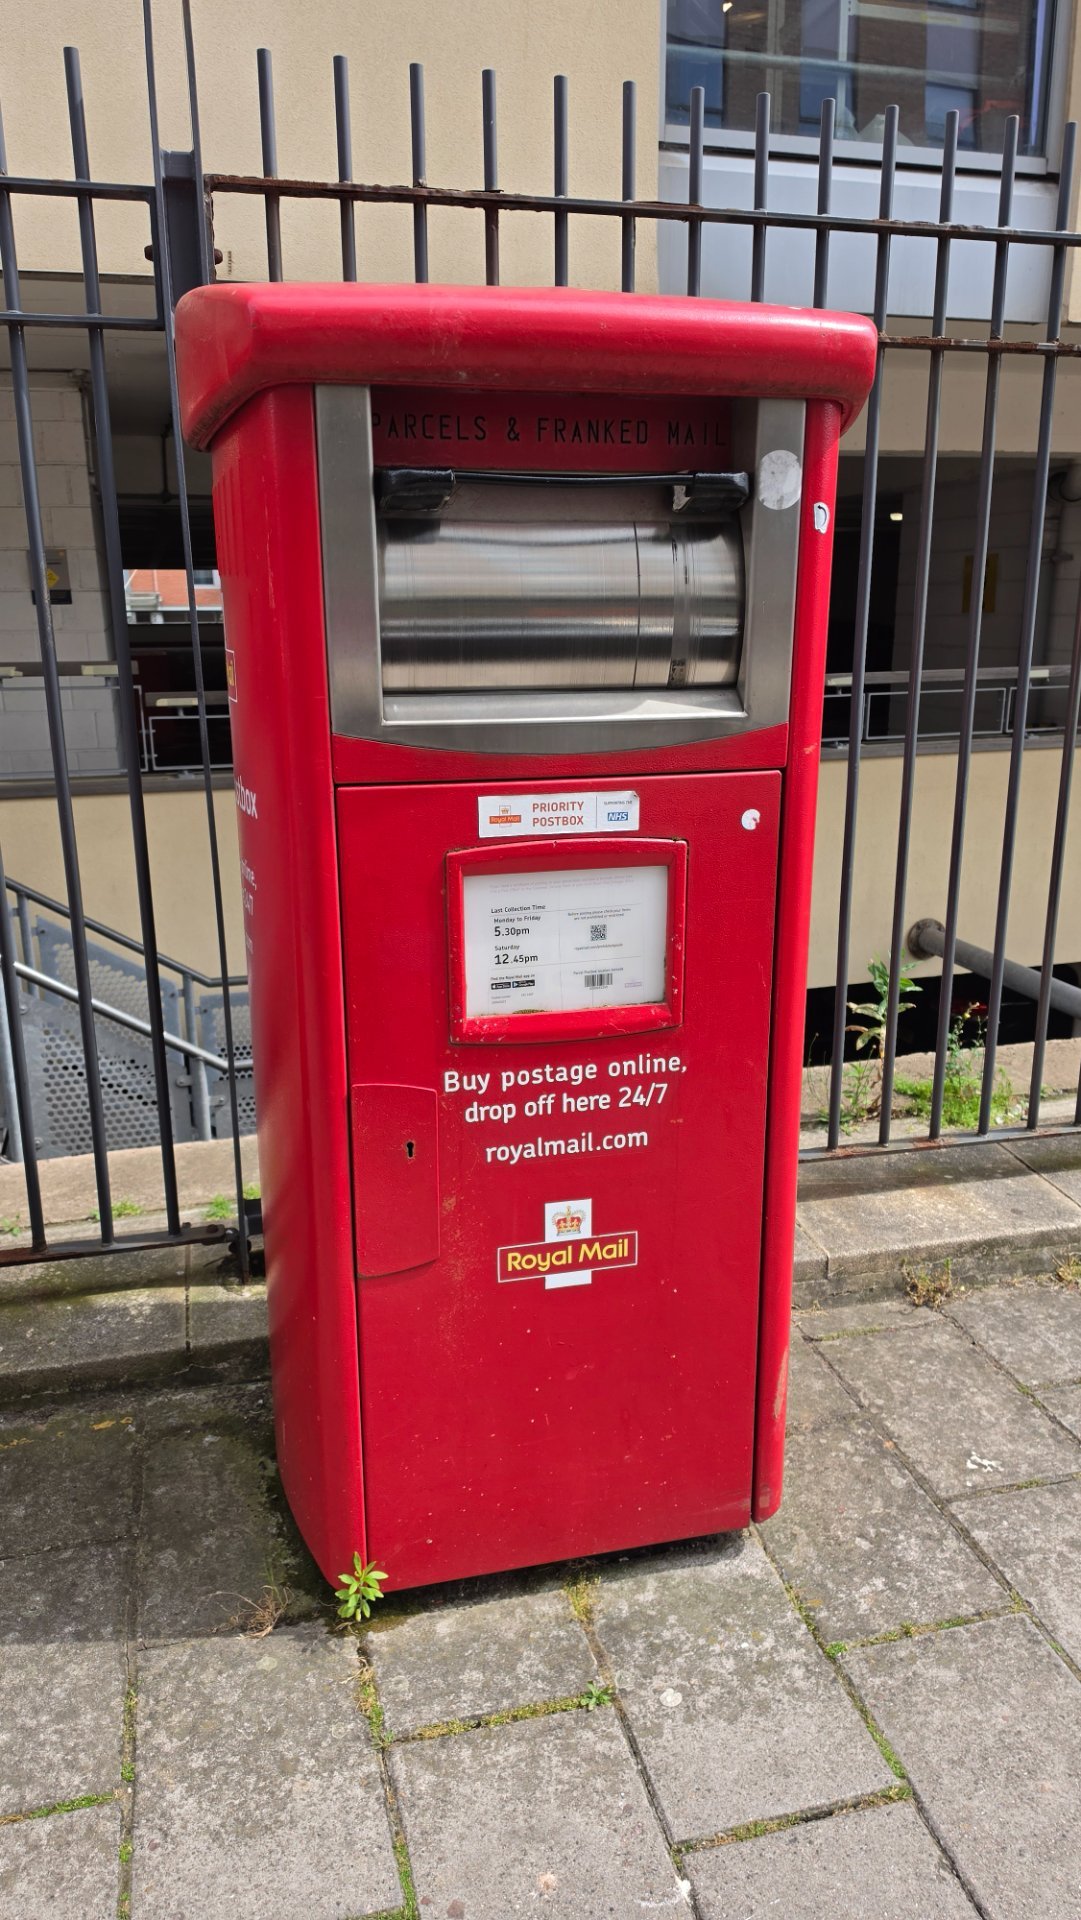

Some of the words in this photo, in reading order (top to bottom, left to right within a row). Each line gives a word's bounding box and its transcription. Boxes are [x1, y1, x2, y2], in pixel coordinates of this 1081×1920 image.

[506, 416, 521, 442] &
[536, 417, 649, 446] FRANKED
[666, 419, 730, 447] MAIL
[532, 801, 585, 813] PRIORITY
[608, 812, 628, 821] NHS
[532, 815, 585, 827] POSTBOX
[493, 925, 530, 937] 5.30pm
[493, 953, 539, 965] 12.45pm
[443, 1071, 491, 1095] Buy
[500, 1063, 598, 1092] postage
[607, 1053, 688, 1077] online,
[464, 1101, 517, 1124] drop
[523, 1093, 556, 1117] off
[561, 1092, 612, 1114] here
[617, 1082, 669, 1108] 24/7
[485, 1130, 649, 1165] royalmail.com
[506, 1245, 573, 1272] Royal
[578, 1237, 630, 1263] Mail
